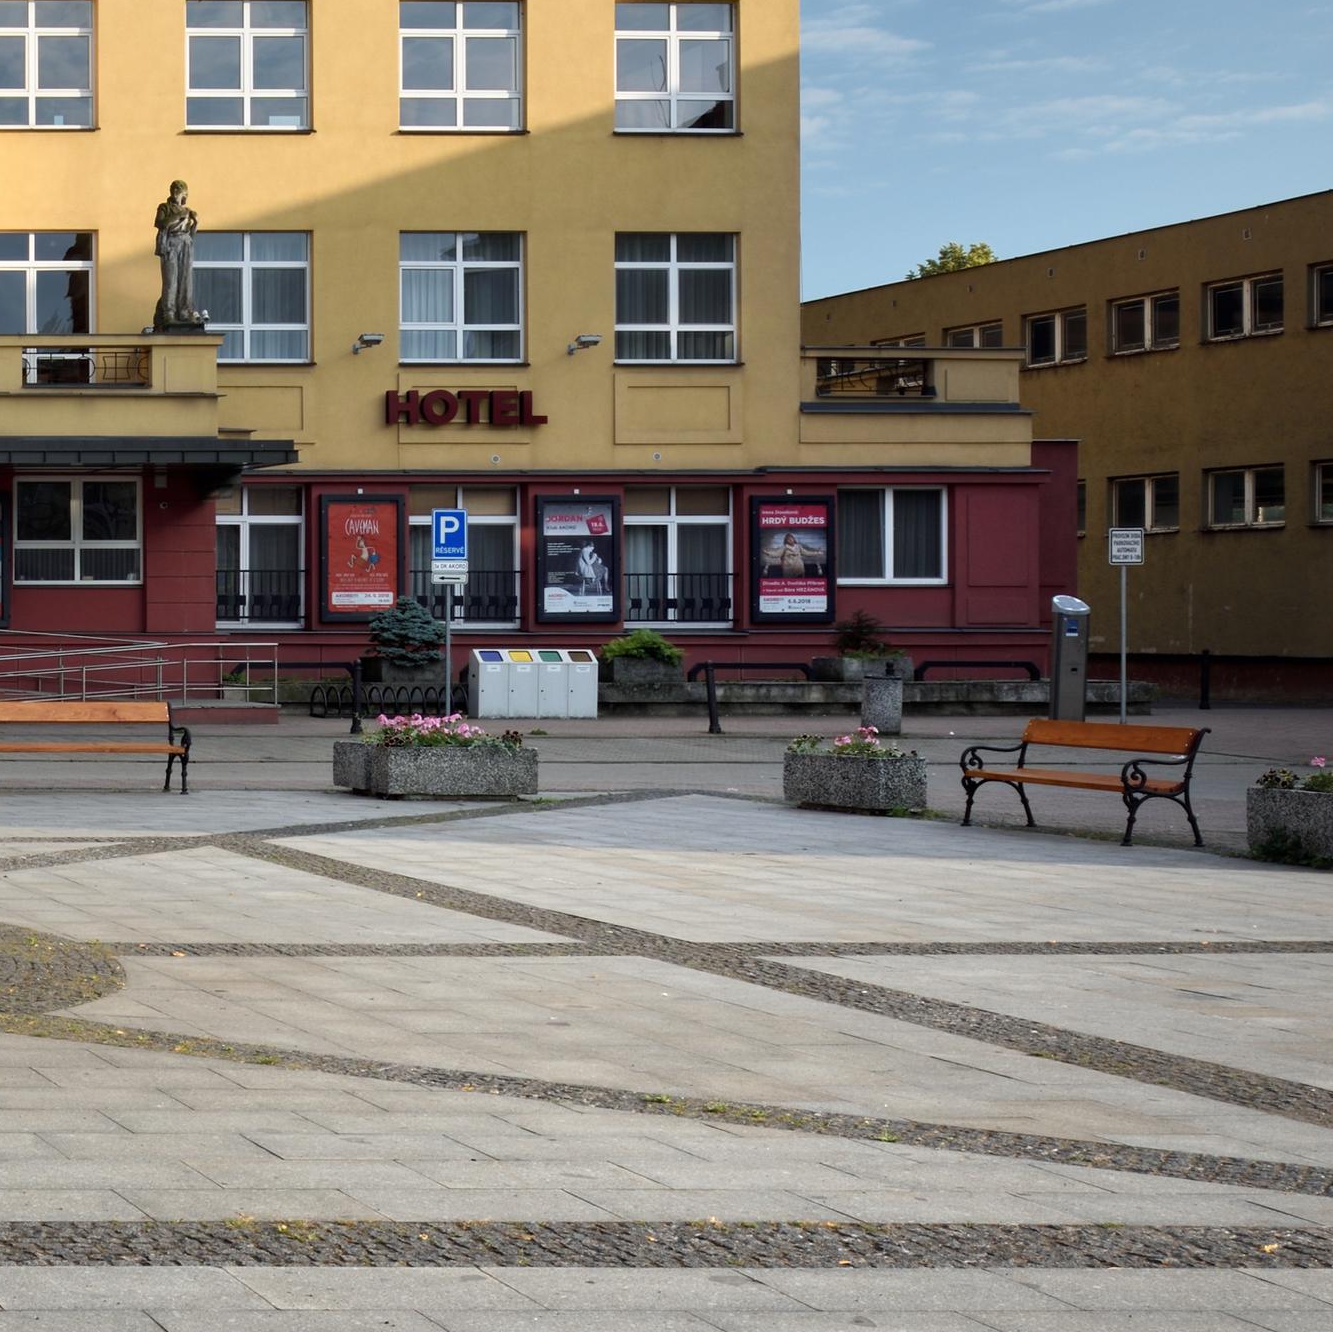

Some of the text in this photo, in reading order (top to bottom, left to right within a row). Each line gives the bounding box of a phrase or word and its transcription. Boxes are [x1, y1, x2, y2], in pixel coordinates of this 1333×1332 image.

[385, 389, 548, 426] HOTEL
[345, 518, 379, 536] CAVEMAN
[439, 516, 460, 544] P
[762, 515, 825, 525] HRDÝ BUDŽES
